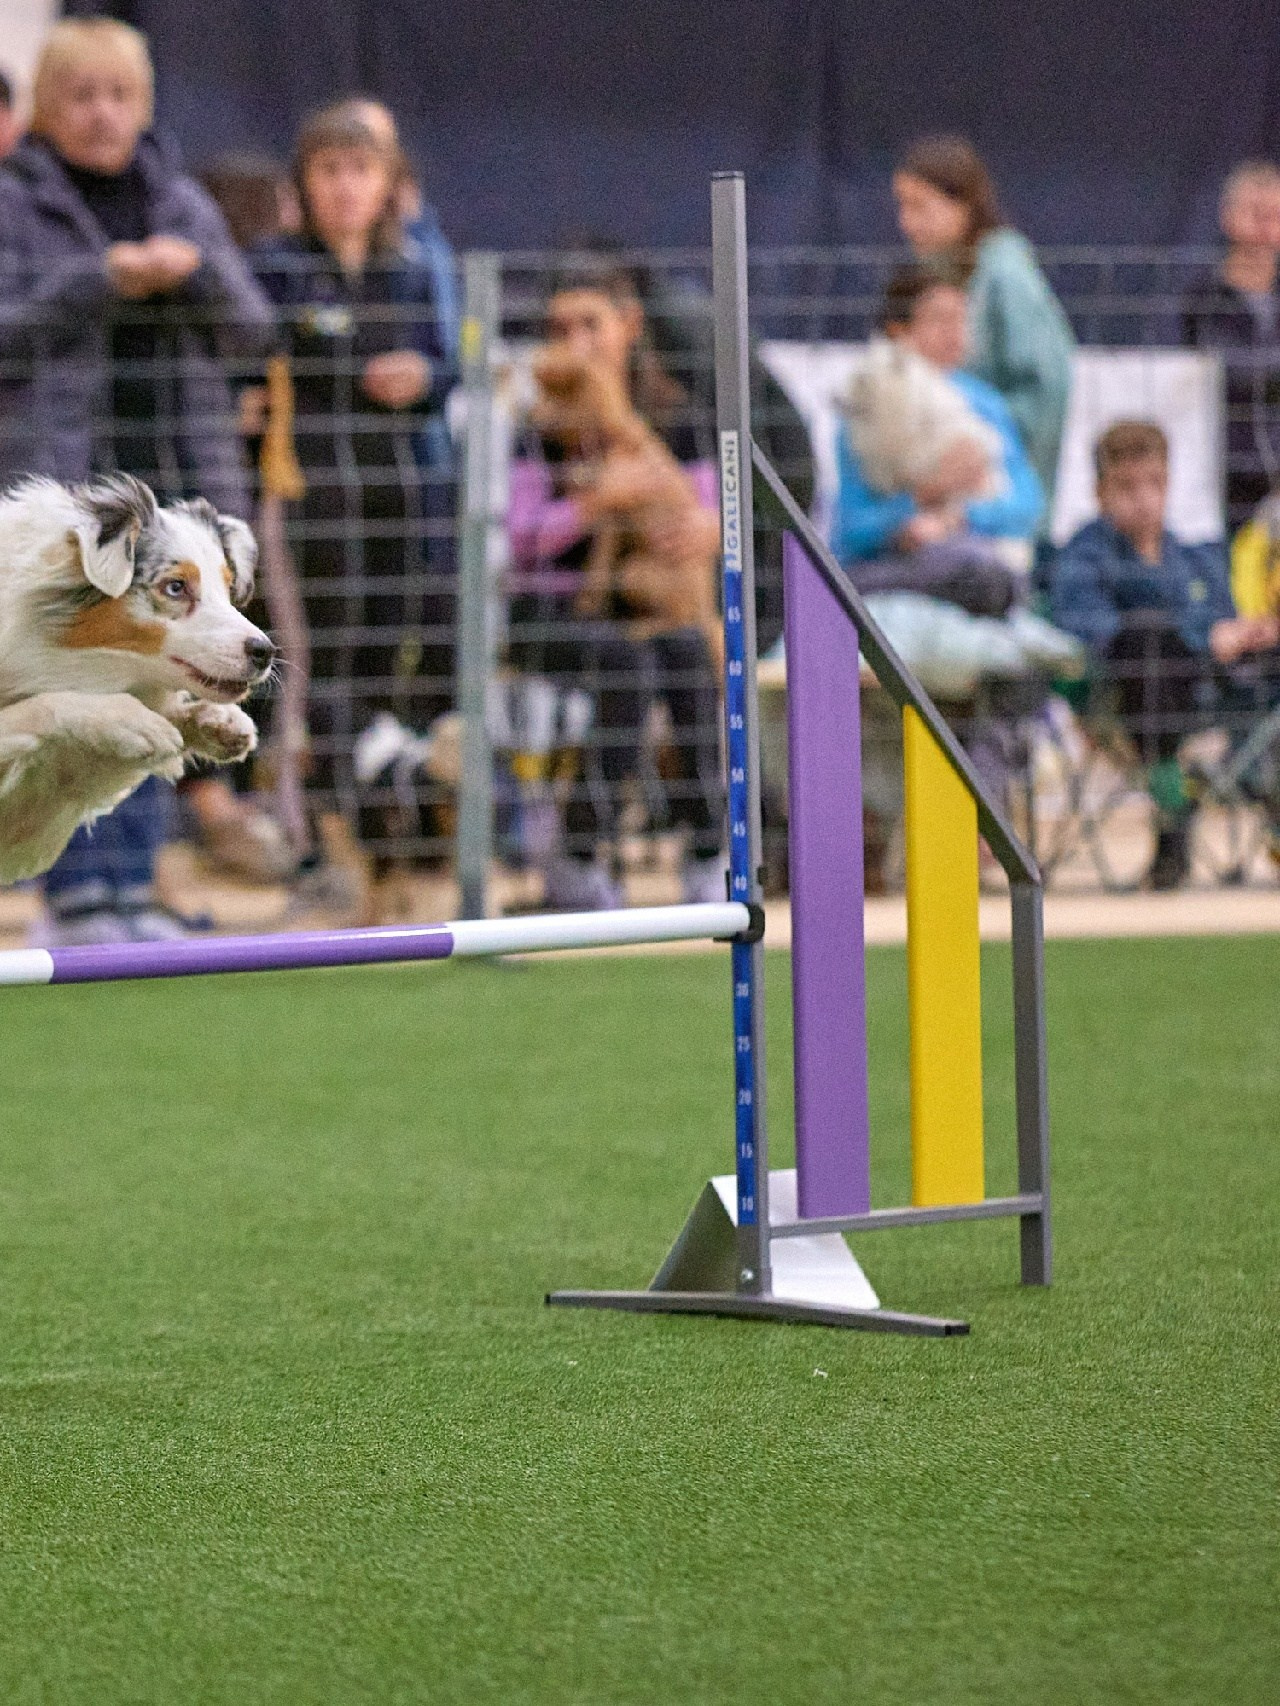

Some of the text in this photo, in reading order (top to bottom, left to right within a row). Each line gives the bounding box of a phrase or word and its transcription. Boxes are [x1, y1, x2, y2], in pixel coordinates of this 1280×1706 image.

[733, 821, 746, 837] 45
[741, 1142, 753, 1159] 15
[742, 1196, 754, 1211] 10
